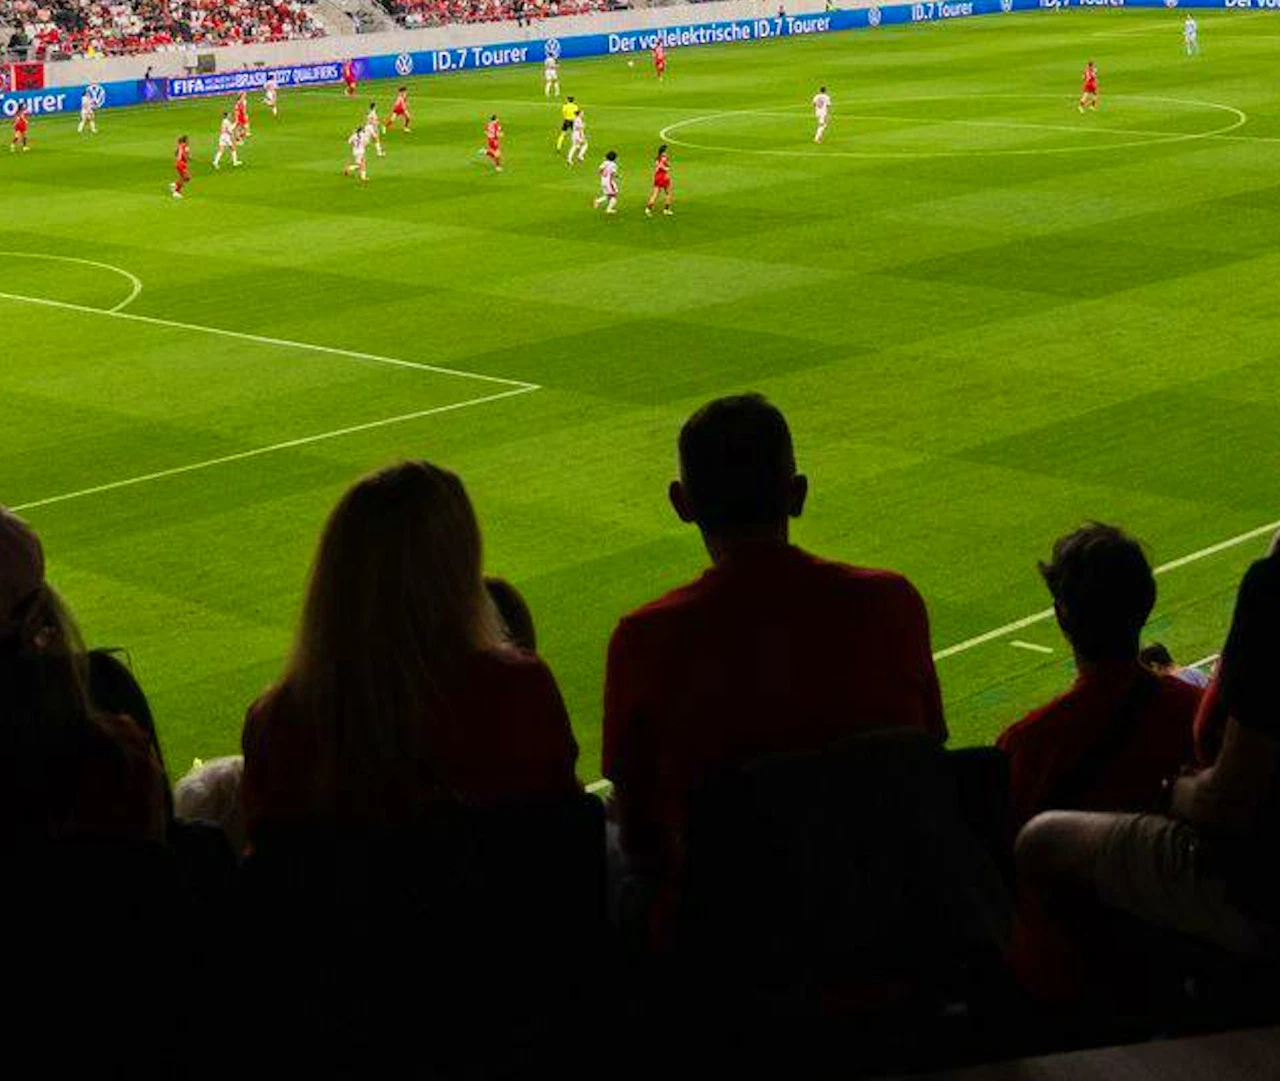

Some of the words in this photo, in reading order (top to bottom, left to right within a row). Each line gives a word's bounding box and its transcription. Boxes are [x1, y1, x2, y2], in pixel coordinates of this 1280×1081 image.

[912, 3, 935, 21] ID.7
[936, 1, 973, 17] Tourer
[608, 33, 637, 52] Der
[639, 22, 750, 49] vollelektrische
[754, 19, 783, 39] ID.7
[786, 15, 832, 34] Tourer
[432, 48, 468, 71] ID.7
[472, 46, 528, 67] Tourer
[173, 77, 205, 95] FIFA
